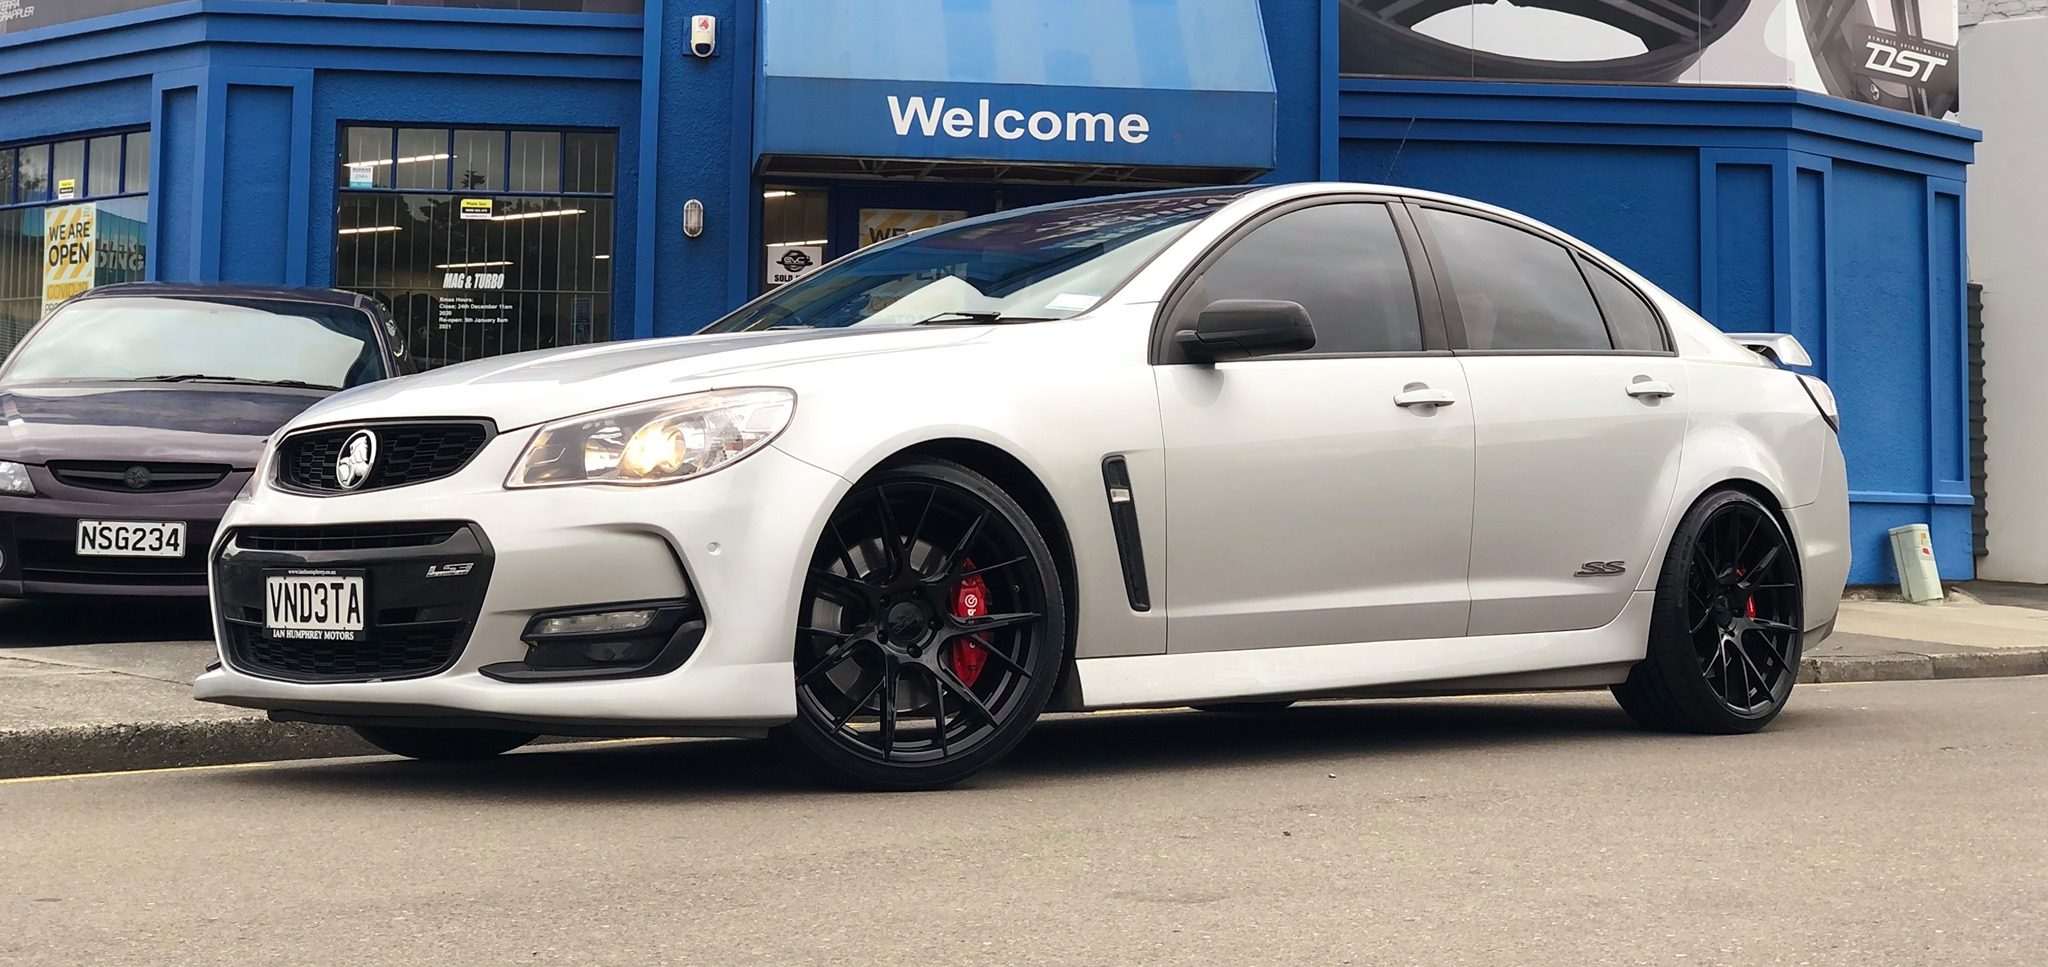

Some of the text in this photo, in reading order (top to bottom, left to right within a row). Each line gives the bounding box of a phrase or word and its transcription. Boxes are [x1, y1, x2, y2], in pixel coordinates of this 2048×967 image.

[1865, 41, 1949, 82] DST
[887, 95, 1150, 144] Welcome
[49, 222, 91, 241] WE ARE
[49, 242, 90, 267] OPEN
[443, 272, 505, 289] MAG & TURBO
[774, 274, 793, 283] SOLD
[474, 317, 496, 325] January
[81, 525, 180, 551] NSG234
[1573, 560, 1626, 578] SS
[269, 582, 361, 624] VND3TA
[272, 628, 355, 641] IAN HUMPHREY MOTORS
